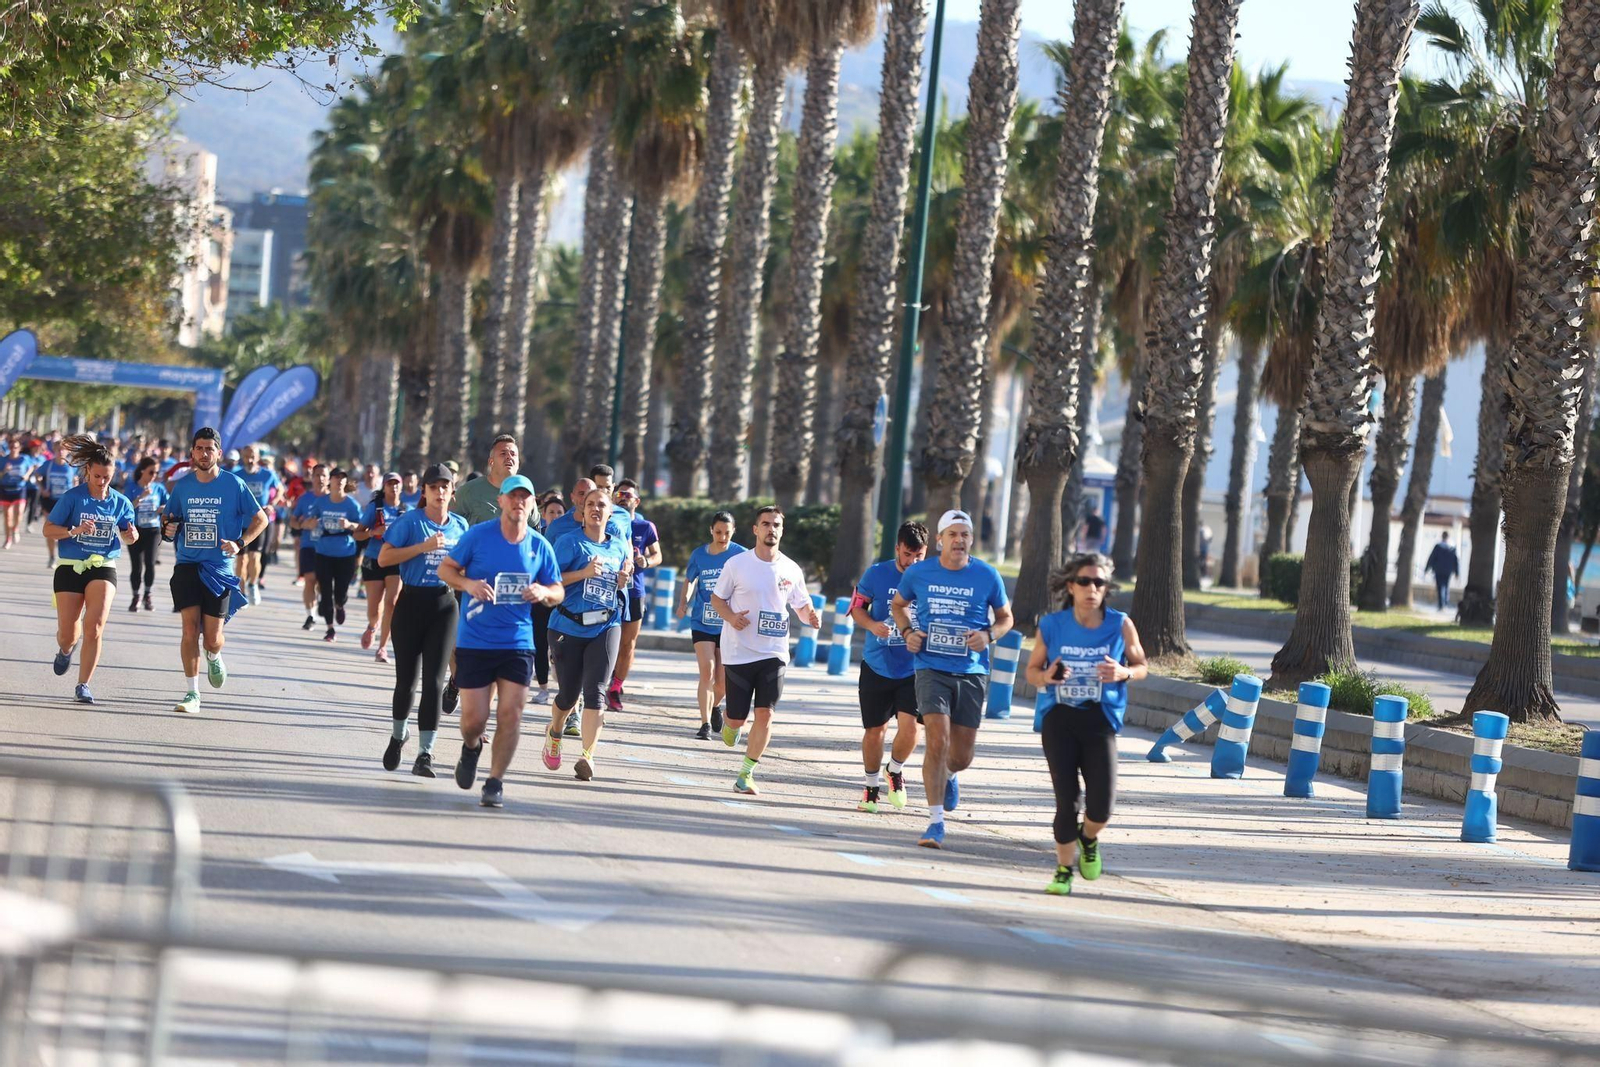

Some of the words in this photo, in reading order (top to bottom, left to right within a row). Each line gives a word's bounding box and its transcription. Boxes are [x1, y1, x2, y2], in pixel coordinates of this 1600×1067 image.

[247, 379, 305, 434] mayoral
[187, 497, 222, 506] mayoral
[80, 512, 117, 522] mayoral
[188, 532, 213, 540] 2183
[589, 585, 612, 599] 1872
[928, 584, 974, 597] mayoral
[761, 620, 787, 630] 2065
[933, 634, 963, 646] 2012
[1060, 644, 1111, 658] mayoral
[1062, 687, 1095, 697] 1856
